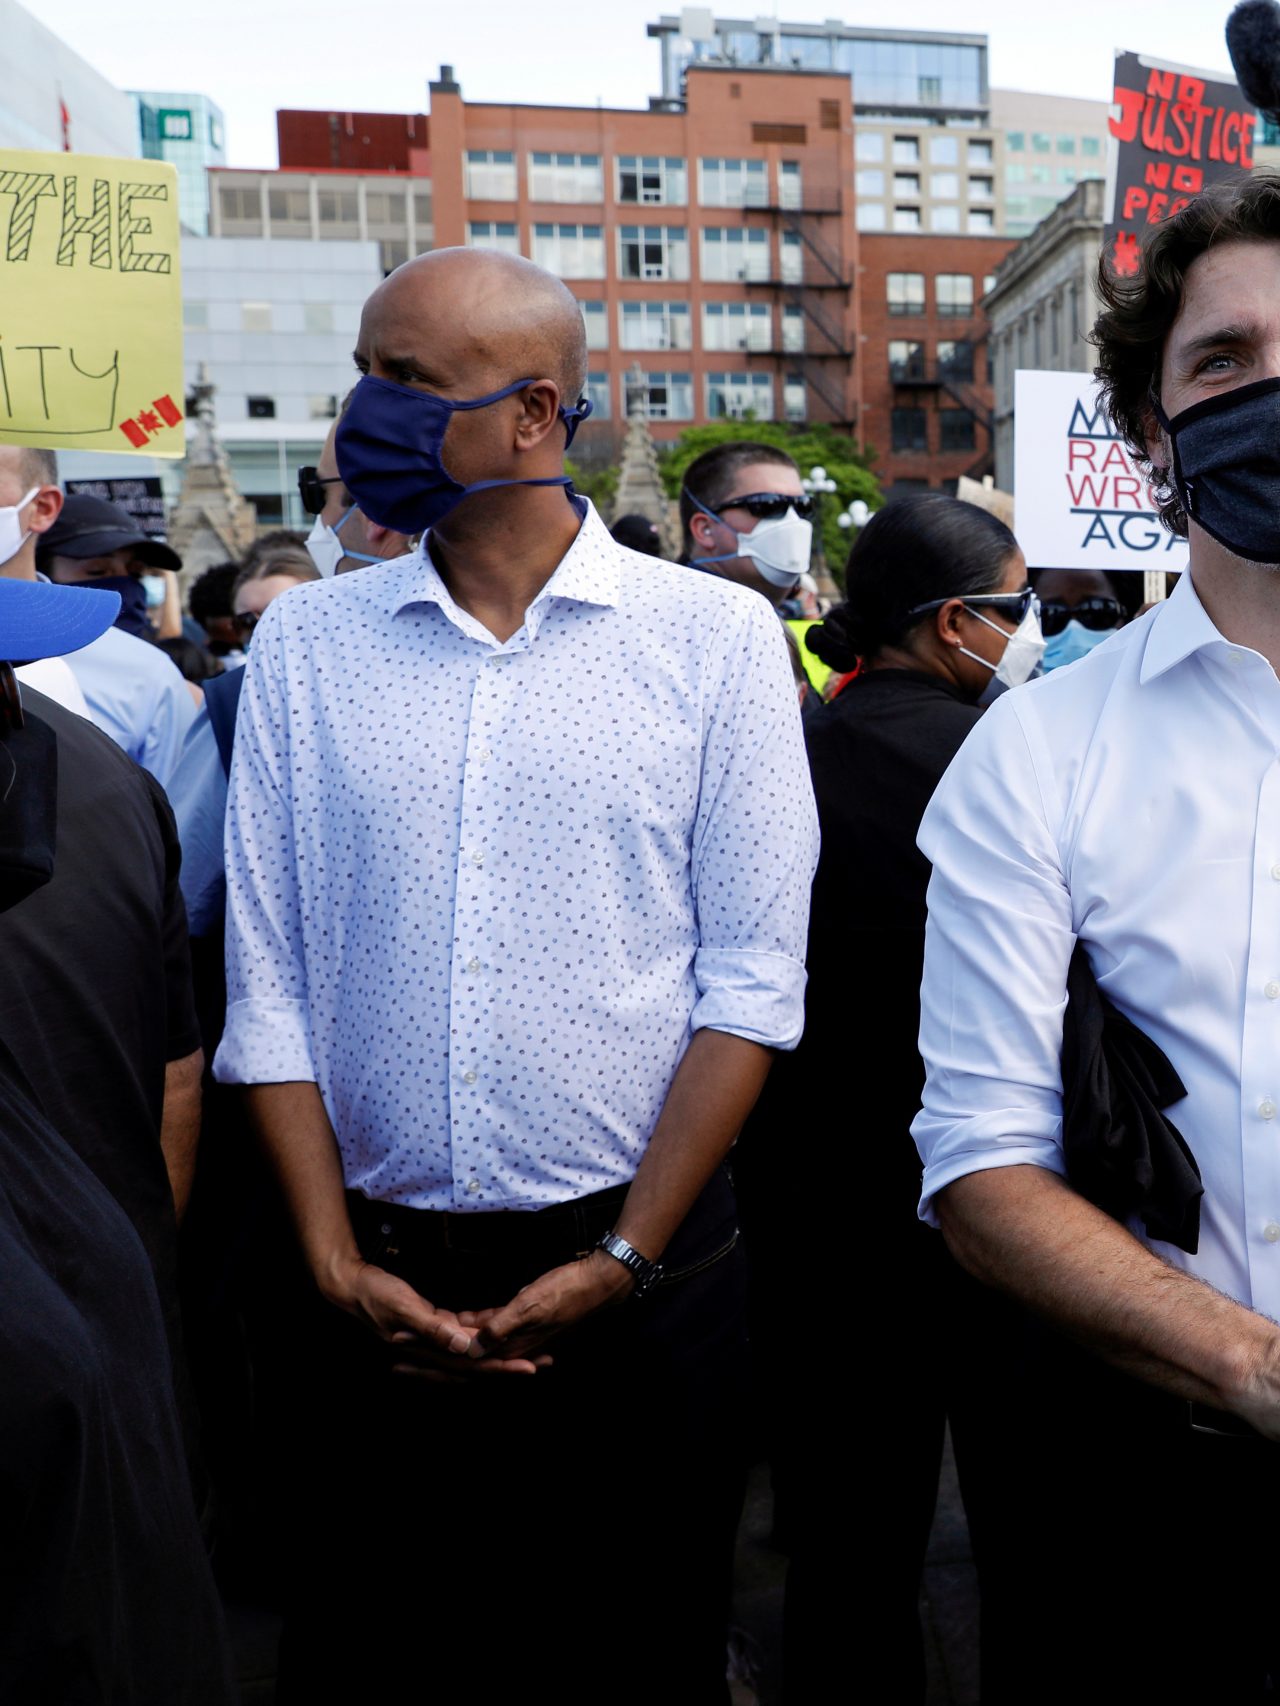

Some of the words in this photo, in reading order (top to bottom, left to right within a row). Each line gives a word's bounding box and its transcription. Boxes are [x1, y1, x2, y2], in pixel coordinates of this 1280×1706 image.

[1146, 68, 1206, 107] NO
[1107, 86, 1258, 169] JUSTICE
[1144, 162, 1204, 193] NO
[0, 170, 171, 274] THE
[1068, 440, 1148, 476] RA
